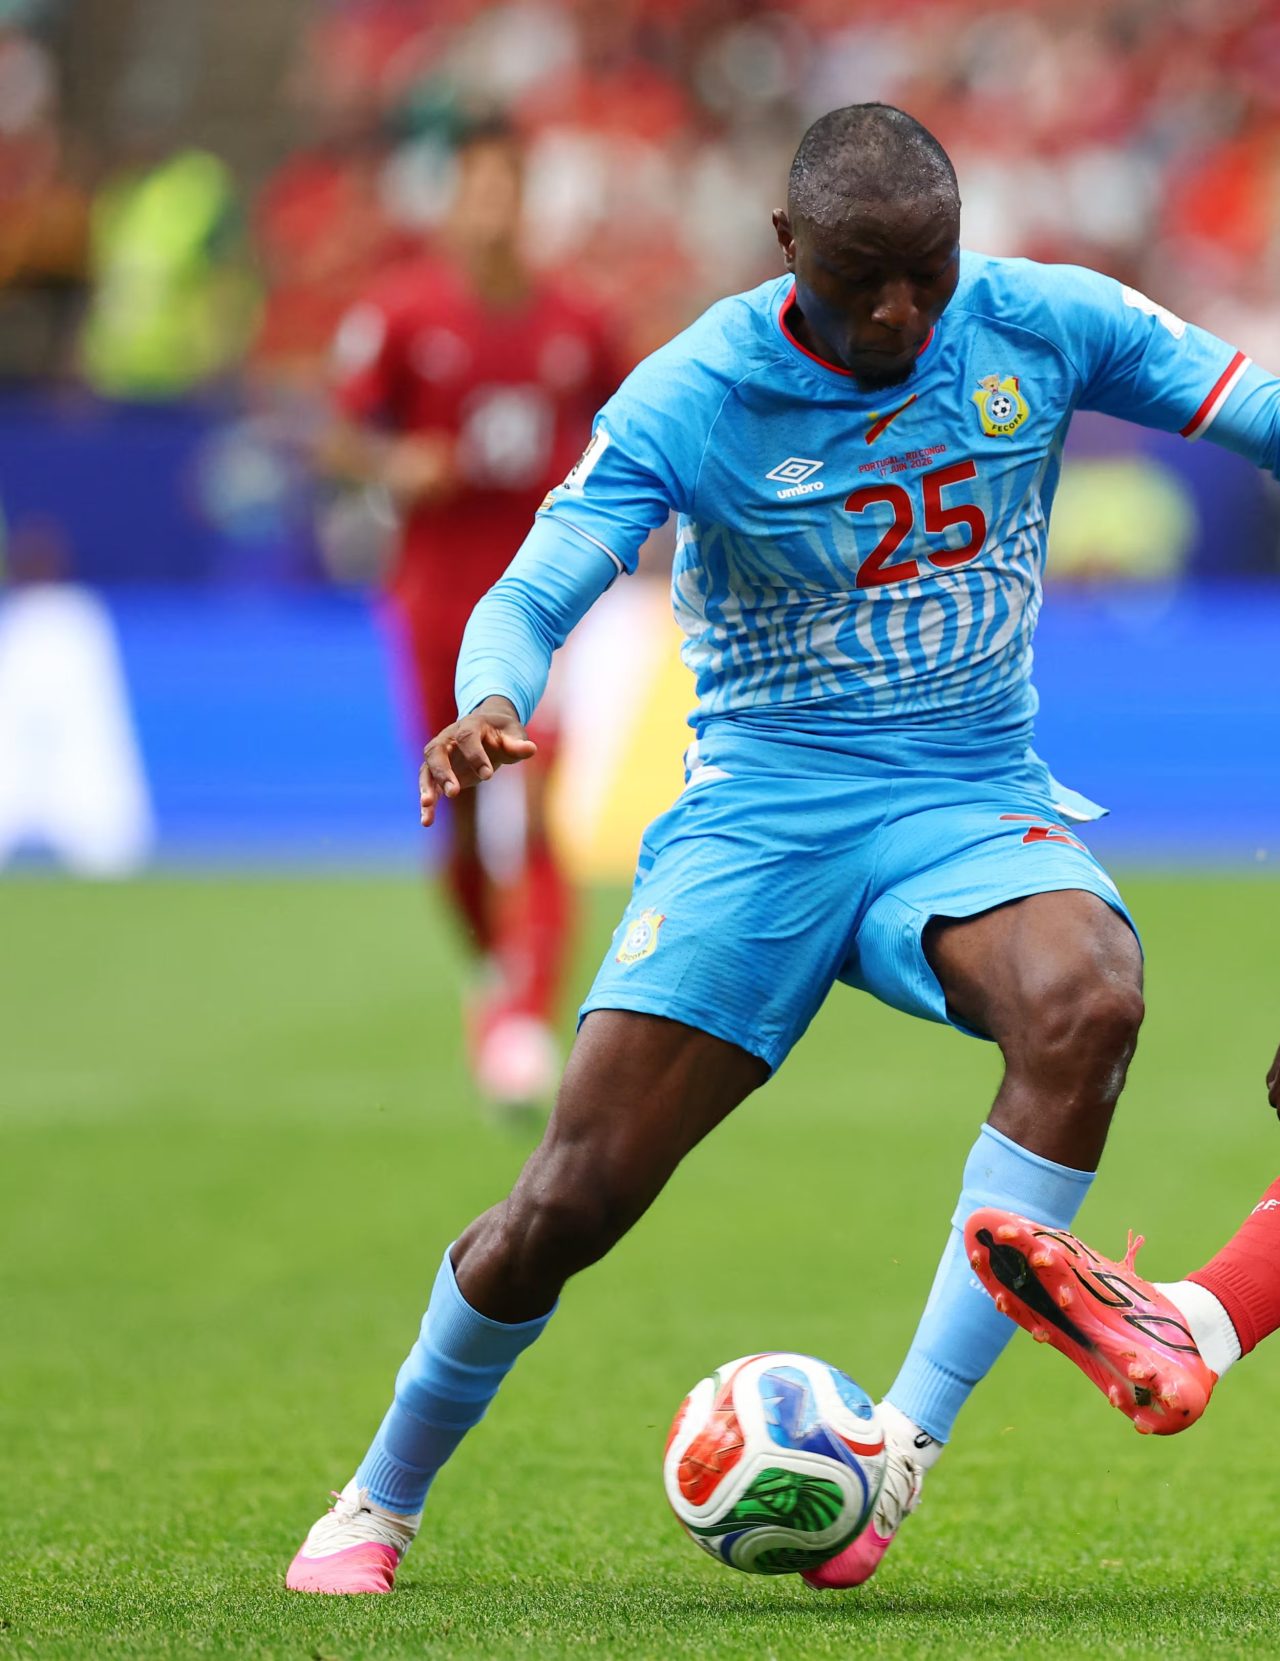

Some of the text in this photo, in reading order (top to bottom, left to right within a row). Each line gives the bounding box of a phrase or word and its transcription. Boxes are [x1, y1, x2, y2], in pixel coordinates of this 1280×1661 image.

[991, 413, 1023, 432] FECOFA
[858, 456, 898, 473] PORTUGAL
[919, 444, 946, 457] CONGO
[890, 462, 908, 474] JUIN
[910, 456, 933, 469] 2026
[776, 480, 824, 500] umbro
[843, 459, 987, 589] 25
